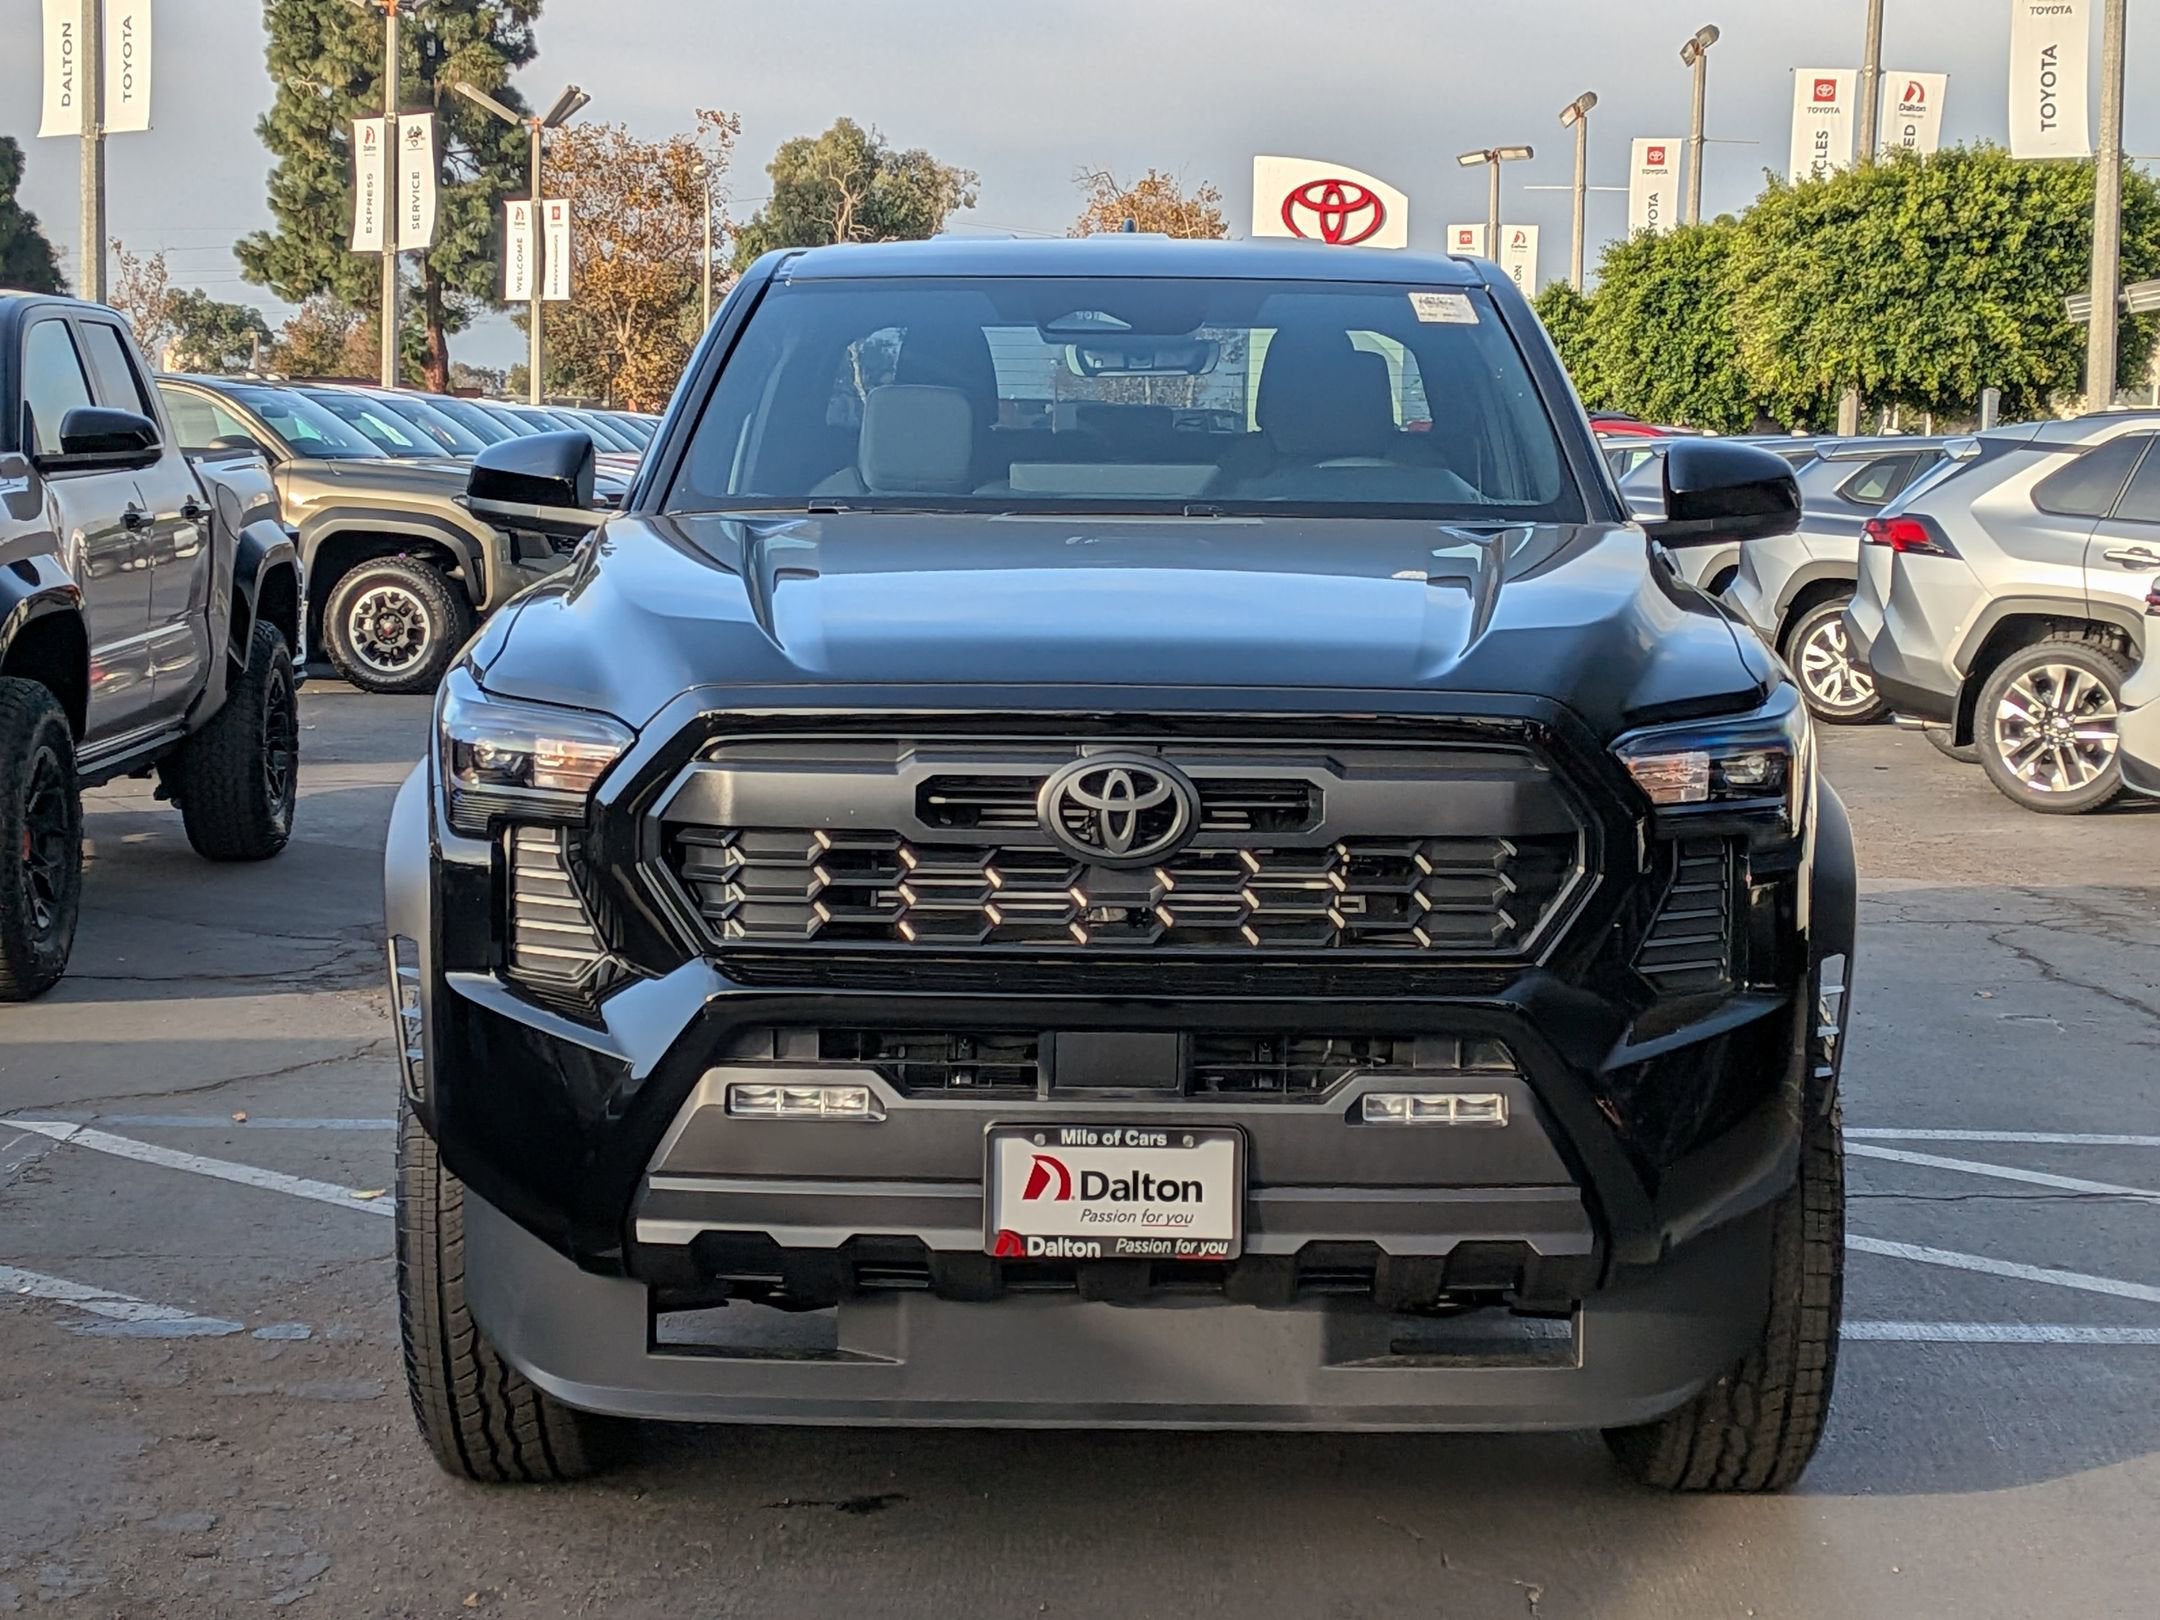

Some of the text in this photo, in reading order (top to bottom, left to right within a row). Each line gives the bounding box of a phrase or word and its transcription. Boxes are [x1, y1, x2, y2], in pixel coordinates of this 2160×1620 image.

[2030, 5, 2073, 15] TOYOTA
[61, 22, 73, 107] DALTON
[122, 15, 133, 103] TOYOTA
[2039, 43, 2058, 132] TOYOTA
[1806, 106, 1841, 115] TOYOTA
[365, 172, 374, 234] EXPRESS
[411, 171, 421, 230] SERVICE
[515, 237, 524, 293] WELCOME
[1060, 1128, 1168, 1147] Mile of Cars
[1080, 1170, 1203, 1203] Dalton
[1080, 1208, 1195, 1226] Passion for you
[1026, 1236, 1229, 1259] Dalton Passion for you
